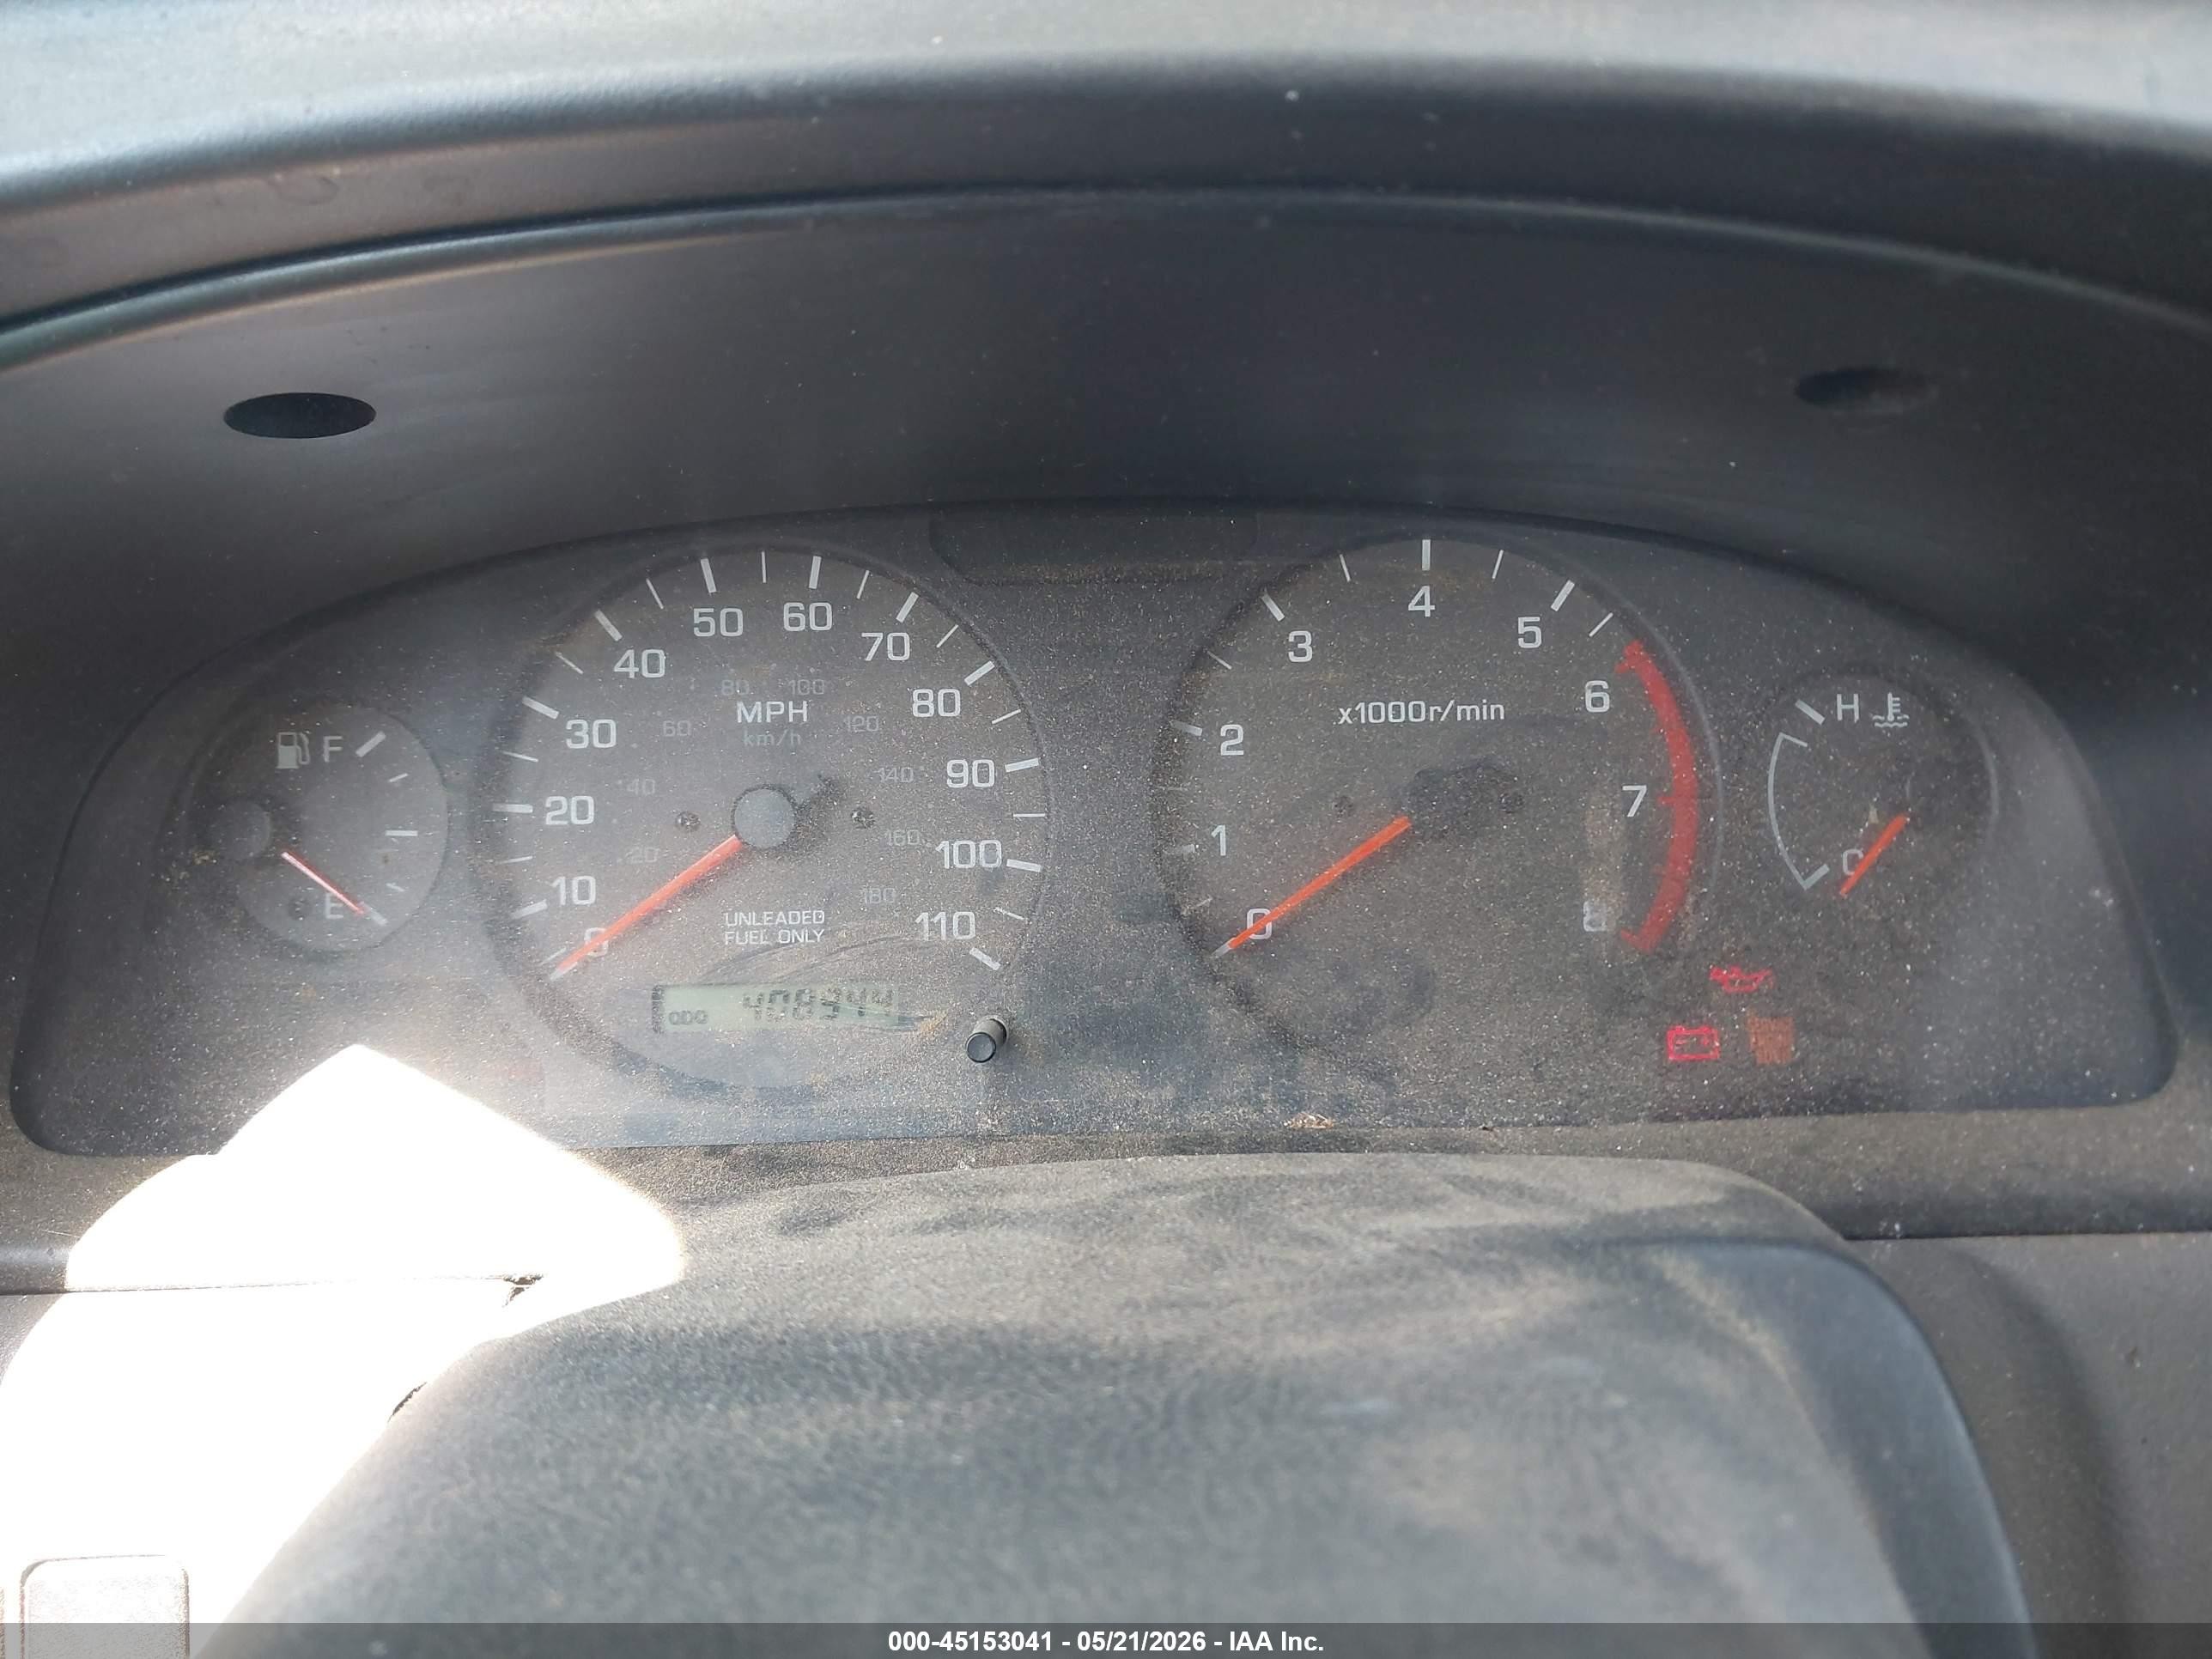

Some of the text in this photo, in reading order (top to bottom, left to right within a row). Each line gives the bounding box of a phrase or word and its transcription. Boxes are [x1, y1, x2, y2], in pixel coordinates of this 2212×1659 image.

[1407, 586, 1436, 617] 4
[693, 608, 744, 637] 50
[783, 602, 833, 631] 60
[861, 632, 910, 661] 70
[1288, 630, 1313, 663] 3
[1517, 616, 1542, 649] 5
[613, 649, 666, 678] 40
[912, 688, 961, 718] 80
[1338, 697, 1505, 725] x1000r/min
[1584, 680, 1610, 713] 6
[1836, 694, 1859, 723] H
[736, 700, 809, 724] MPH
[565, 719, 617, 749] 30
[742, 728, 802, 747] km/h
[1219, 724, 1244, 756] 2
[323, 736, 343, 763] F
[946, 759, 995, 788] 90
[545, 795, 595, 825] 20
[1622, 785, 1647, 817] 7
[935, 839, 1002, 869] 100
[1210, 824, 1226, 856] 1
[551, 876, 596, 906] 10
[723, 909, 825, 927] UNLEADED
[915, 911, 976, 941] 110
[724, 928, 825, 945] FUEL ONLY
[668, 1010, 708, 1026] ODO
